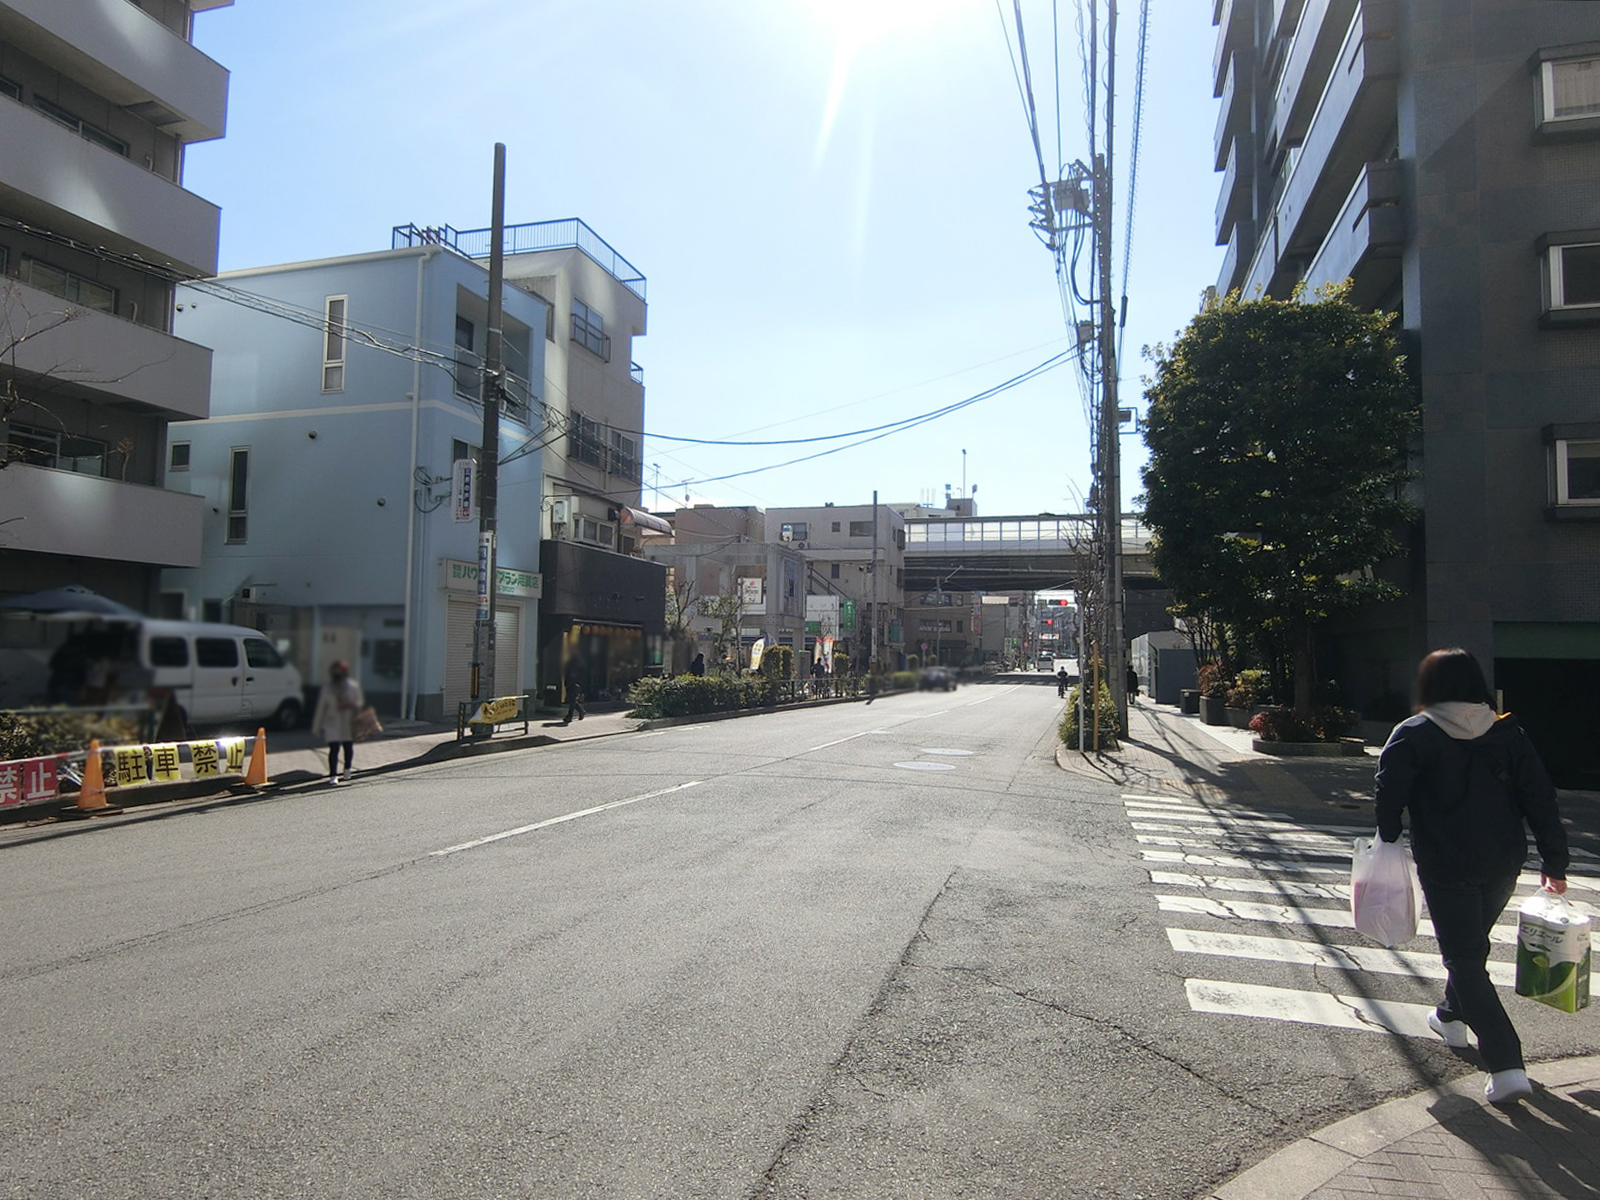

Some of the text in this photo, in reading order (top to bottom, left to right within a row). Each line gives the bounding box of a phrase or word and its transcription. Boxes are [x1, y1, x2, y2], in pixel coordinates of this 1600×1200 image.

[117, 742, 243, 783] 駐車禁止
[1521, 926, 1563, 944] エリエール
